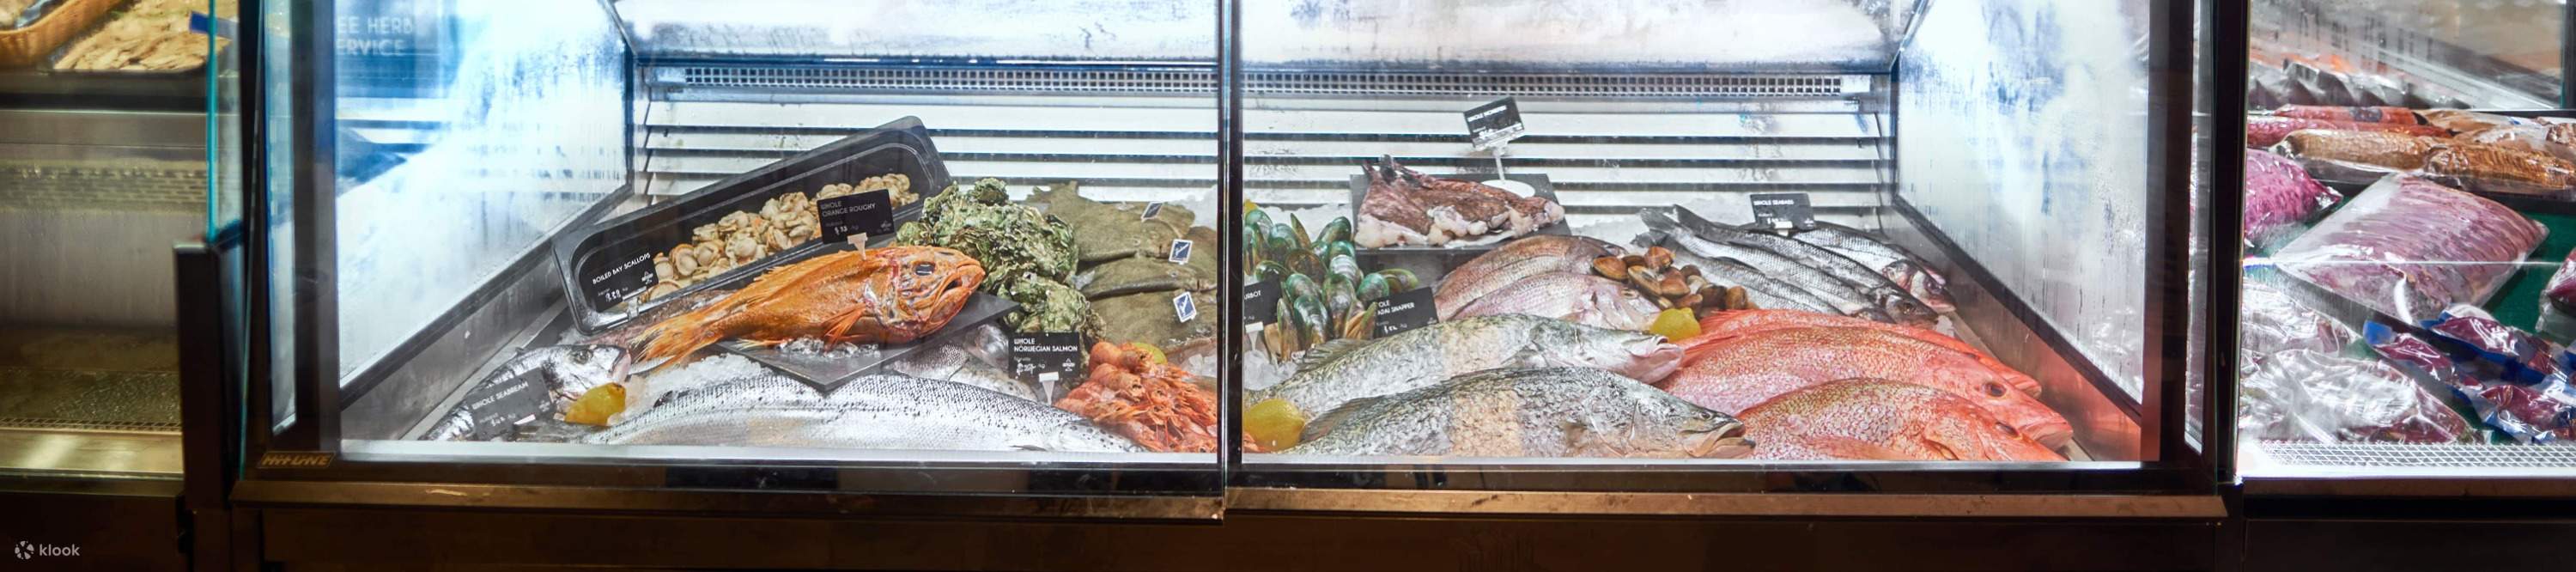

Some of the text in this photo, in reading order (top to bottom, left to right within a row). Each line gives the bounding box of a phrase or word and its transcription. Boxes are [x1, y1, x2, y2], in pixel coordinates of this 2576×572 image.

[822, 206, 848, 217] ORANGE
[592, 253, 651, 285] BOILED BAY SCALLOPS
